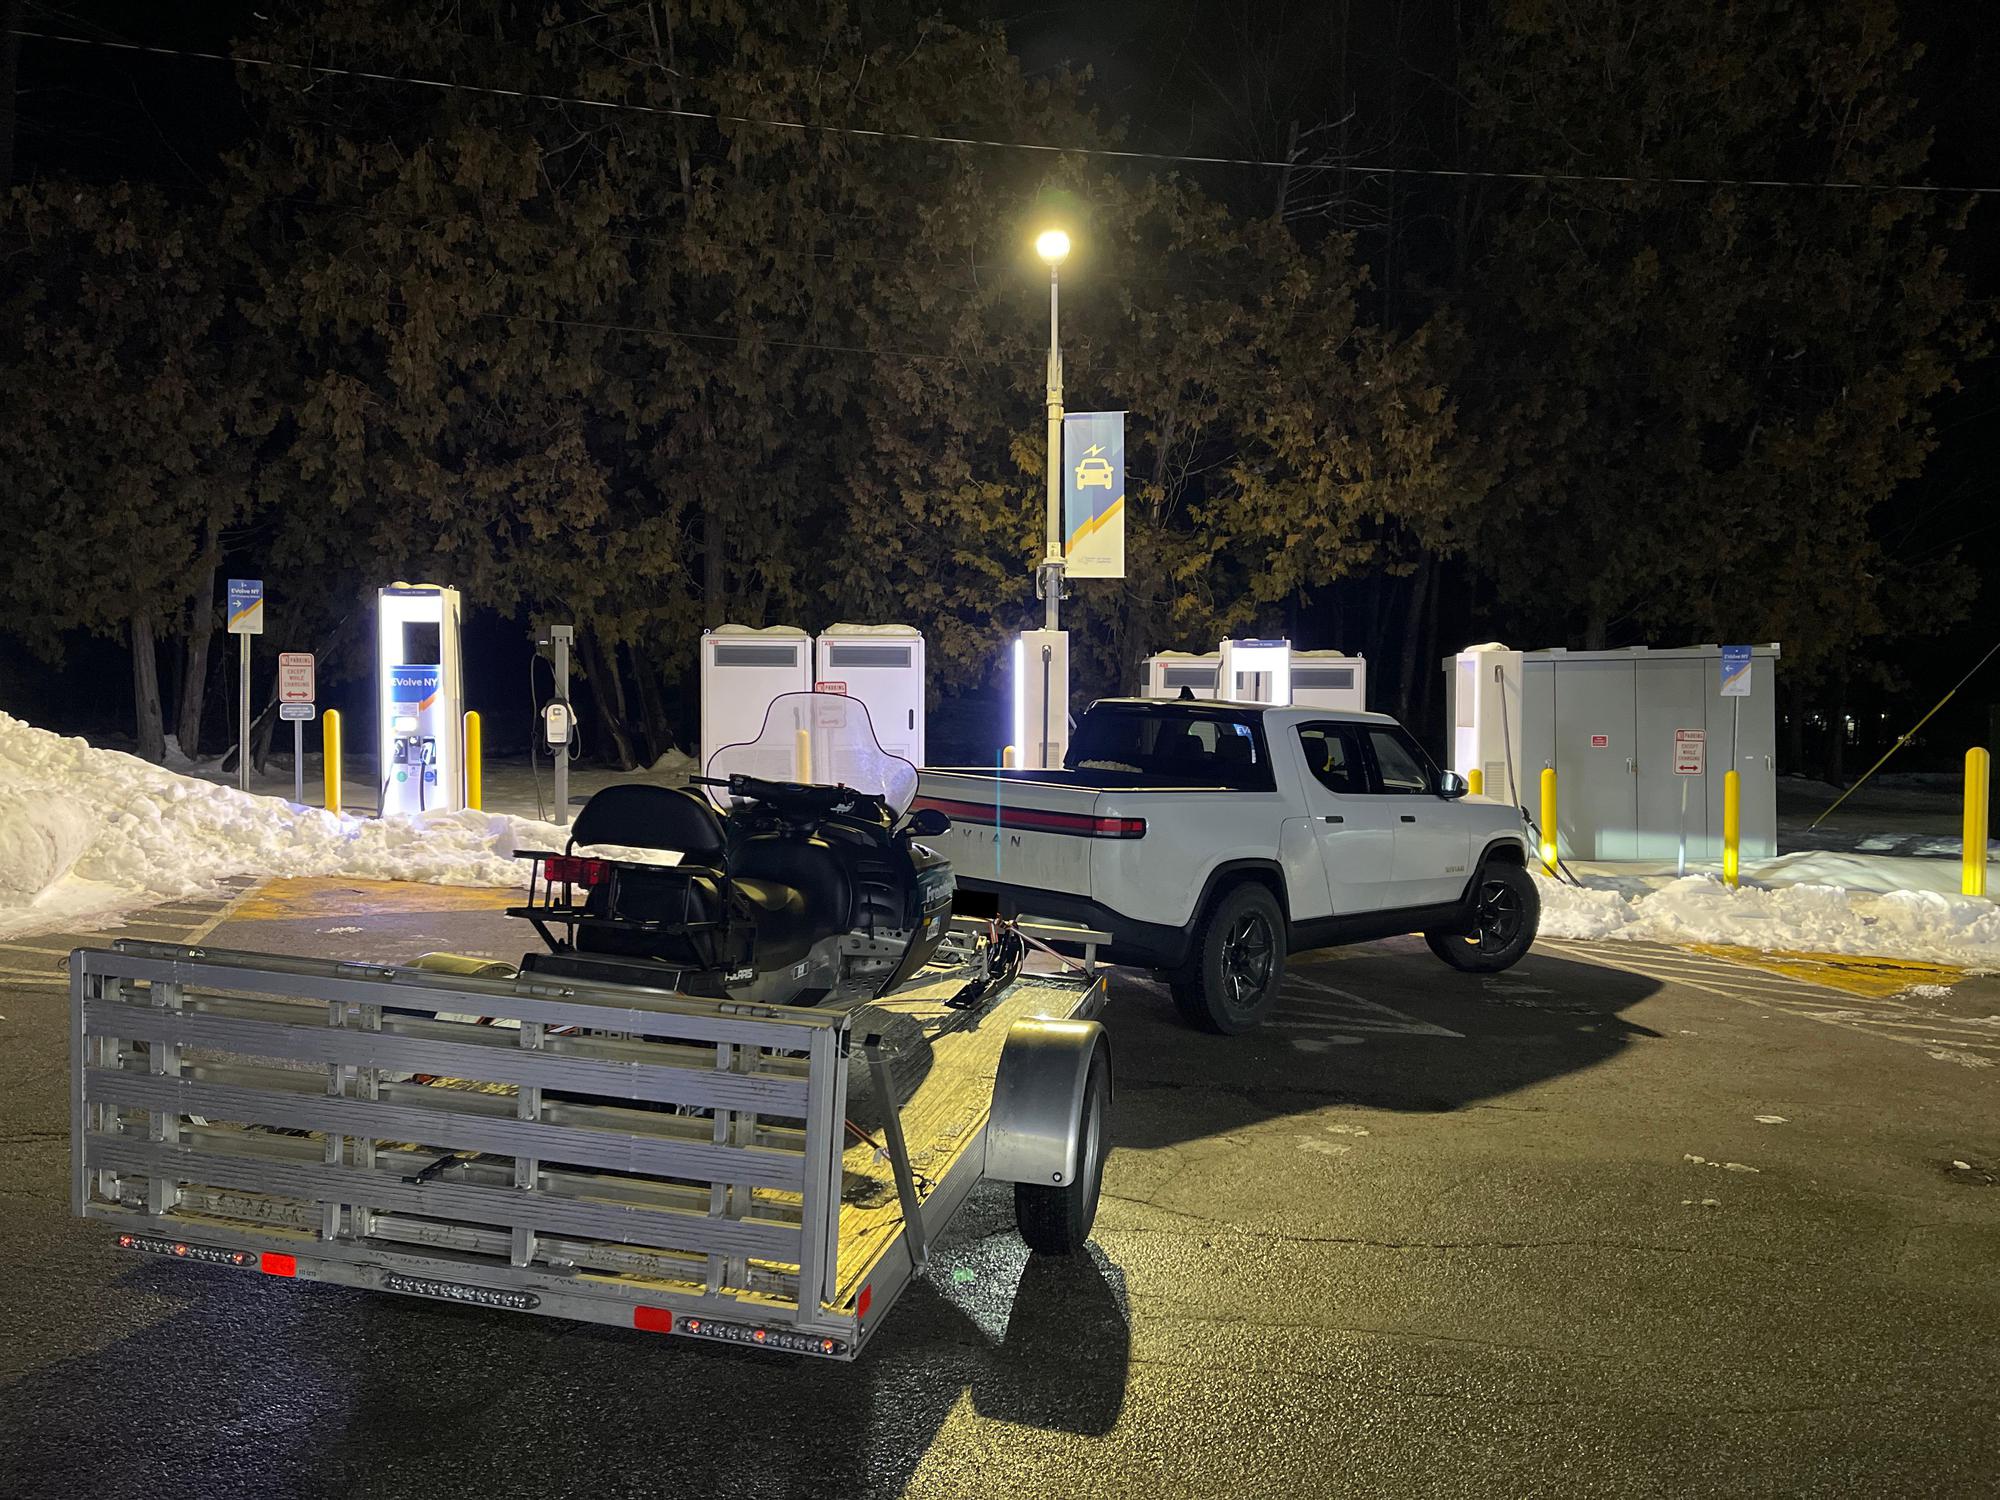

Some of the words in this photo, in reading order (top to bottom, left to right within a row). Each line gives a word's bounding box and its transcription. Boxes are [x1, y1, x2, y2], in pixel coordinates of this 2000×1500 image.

[392, 677, 423, 687] EVolve
[424, 678, 439, 688] NY
[951, 827, 1021, 847] IVIAN
